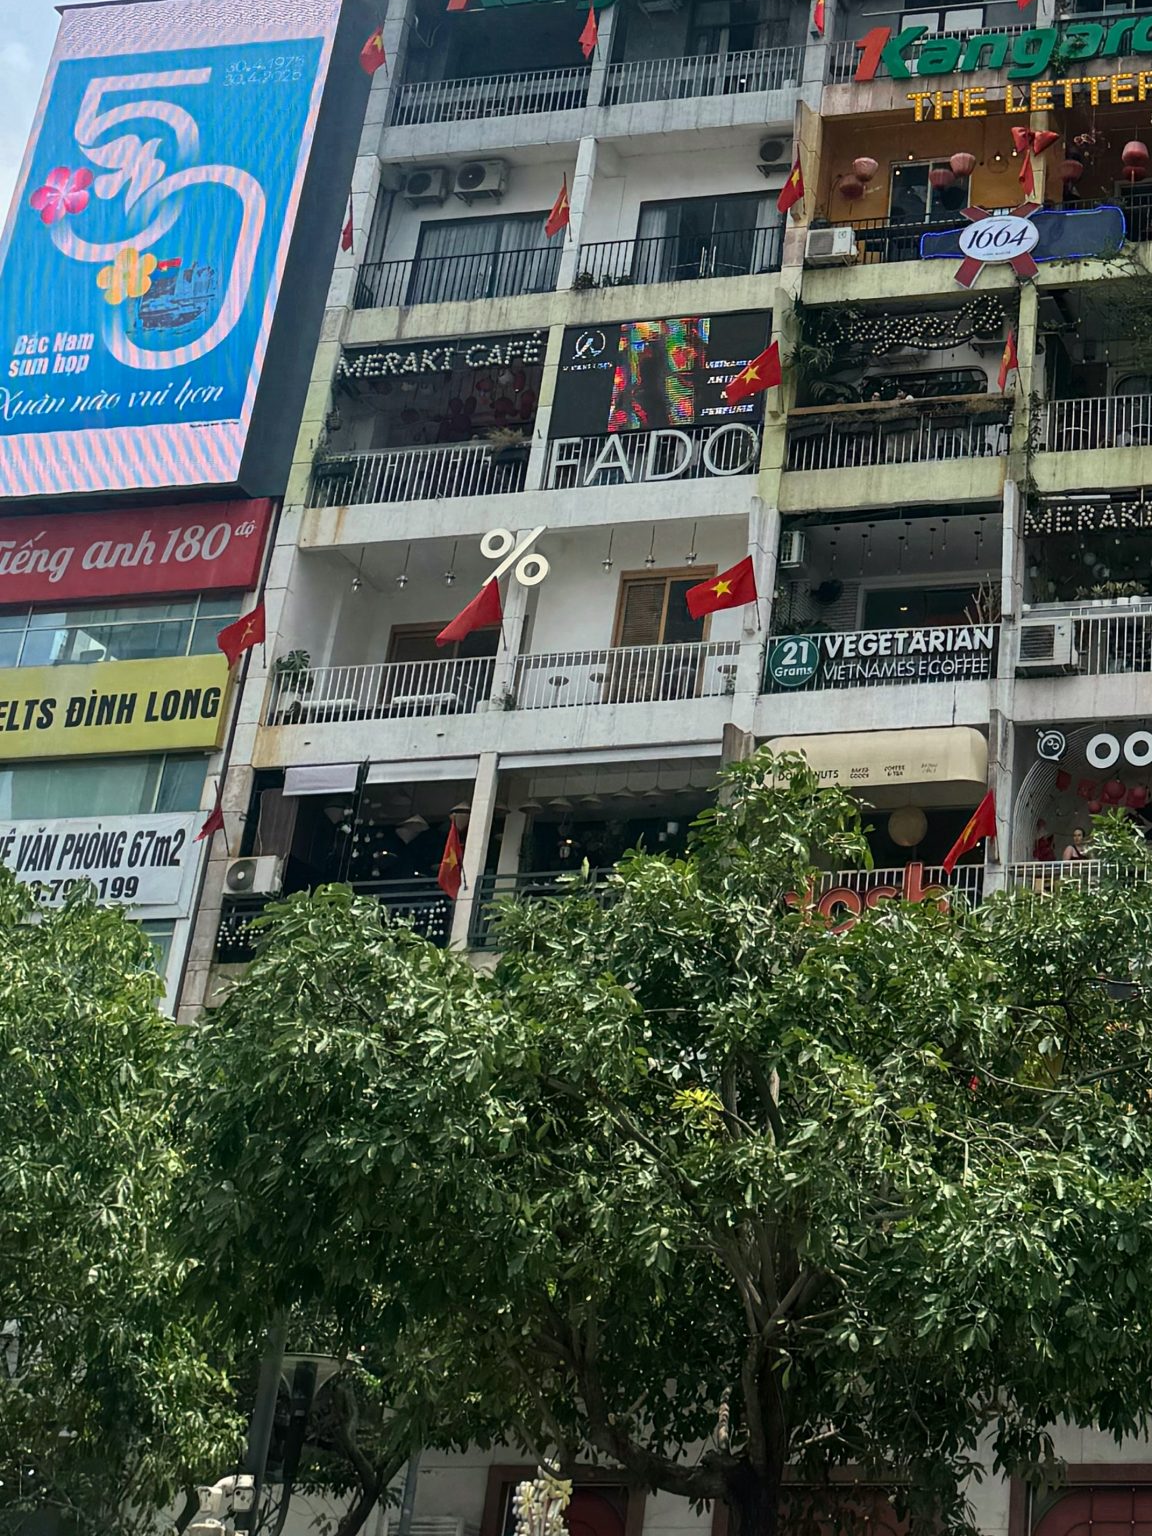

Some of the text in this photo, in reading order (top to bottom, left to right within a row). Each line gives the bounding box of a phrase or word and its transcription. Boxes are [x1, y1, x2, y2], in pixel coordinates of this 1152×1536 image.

[907, 86, 988, 122] THE
[967, 223, 1033, 249] 1664
[53, 331, 95, 352] Nam
[335, 330, 541, 378] MERAKI CAFÉ
[8, 356, 48, 378] sum
[128, 382, 174, 408] vui
[548, 422, 759, 489] FADO
[160, 522, 232, 564] 180
[781, 641, 809, 666] 21
[824, 627, 994, 659] VEGETARIAN
[774, 666, 813, 677] Grams
[928, 657, 991, 676] COFFEE
[64, 689, 138, 729] ĐÌNH
[144, 687, 221, 724] LONG
[17, 827, 59, 873] VĂN
[56, 823, 128, 871] PHÒNG
[128, 828, 186, 868] 67m2
